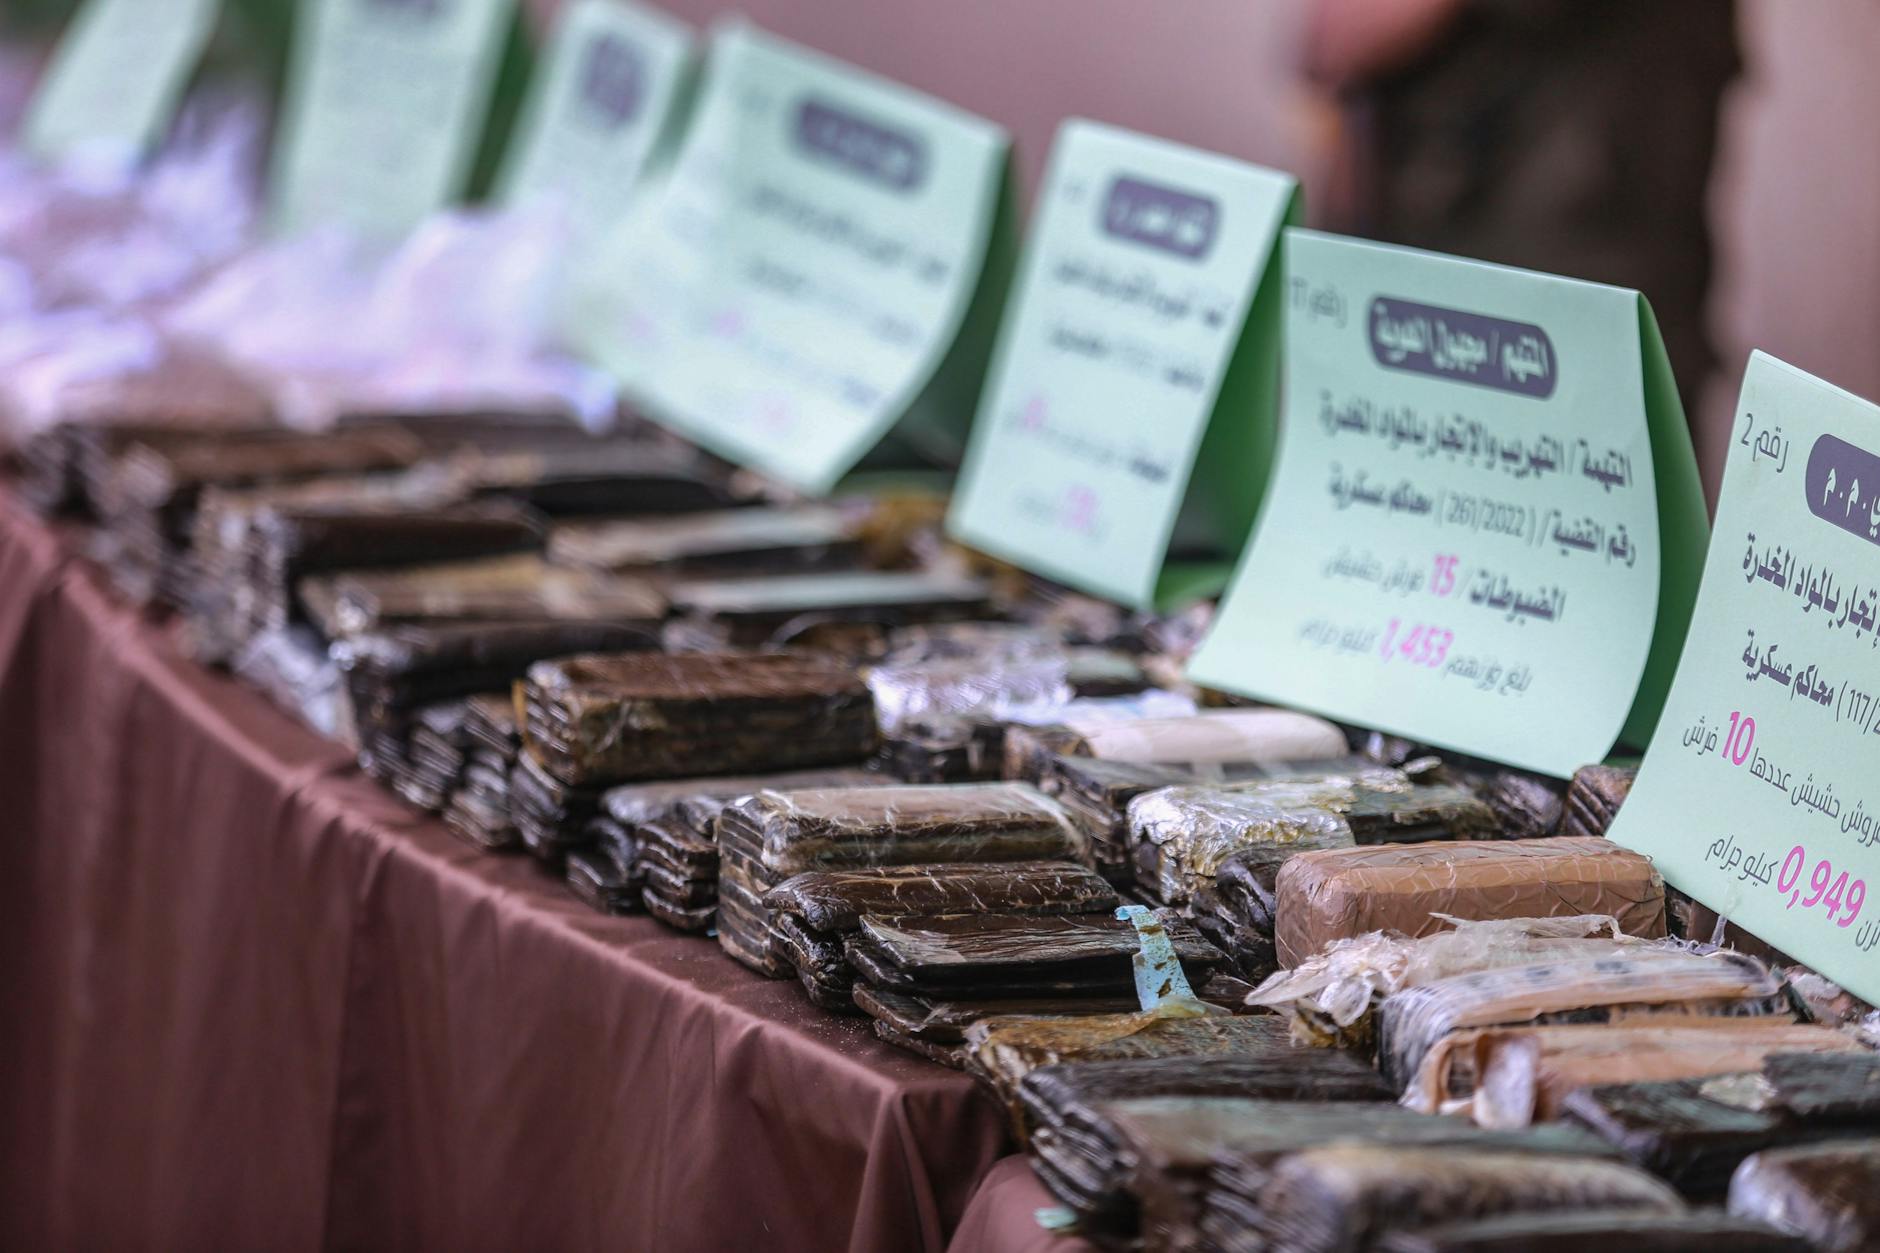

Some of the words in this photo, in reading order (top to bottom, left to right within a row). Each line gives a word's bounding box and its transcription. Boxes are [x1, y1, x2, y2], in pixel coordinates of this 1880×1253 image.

[1740, 412, 1754, 447] 2
[1752, 426, 1789, 474] رقم
[1552, 508, 1606, 557] القضية
[1606, 524, 1637, 569] رقم
[1431, 553, 1459, 597] 15
[1742, 532, 1797, 592] المخدرة
[1794, 563, 1841, 630] بالمواد
[1742, 628, 1792, 687] عسكرية
[1790, 664, 1835, 708] محاكم
[1721, 711, 1756, 766] 10
[1749, 747, 1792, 792] عددها
[1791, 772, 1841, 819] حشيش
[1705, 834, 1743, 873] جرام
[1738, 852, 1779, 888] كيلو
[1777, 845, 1866, 928] 0,949
